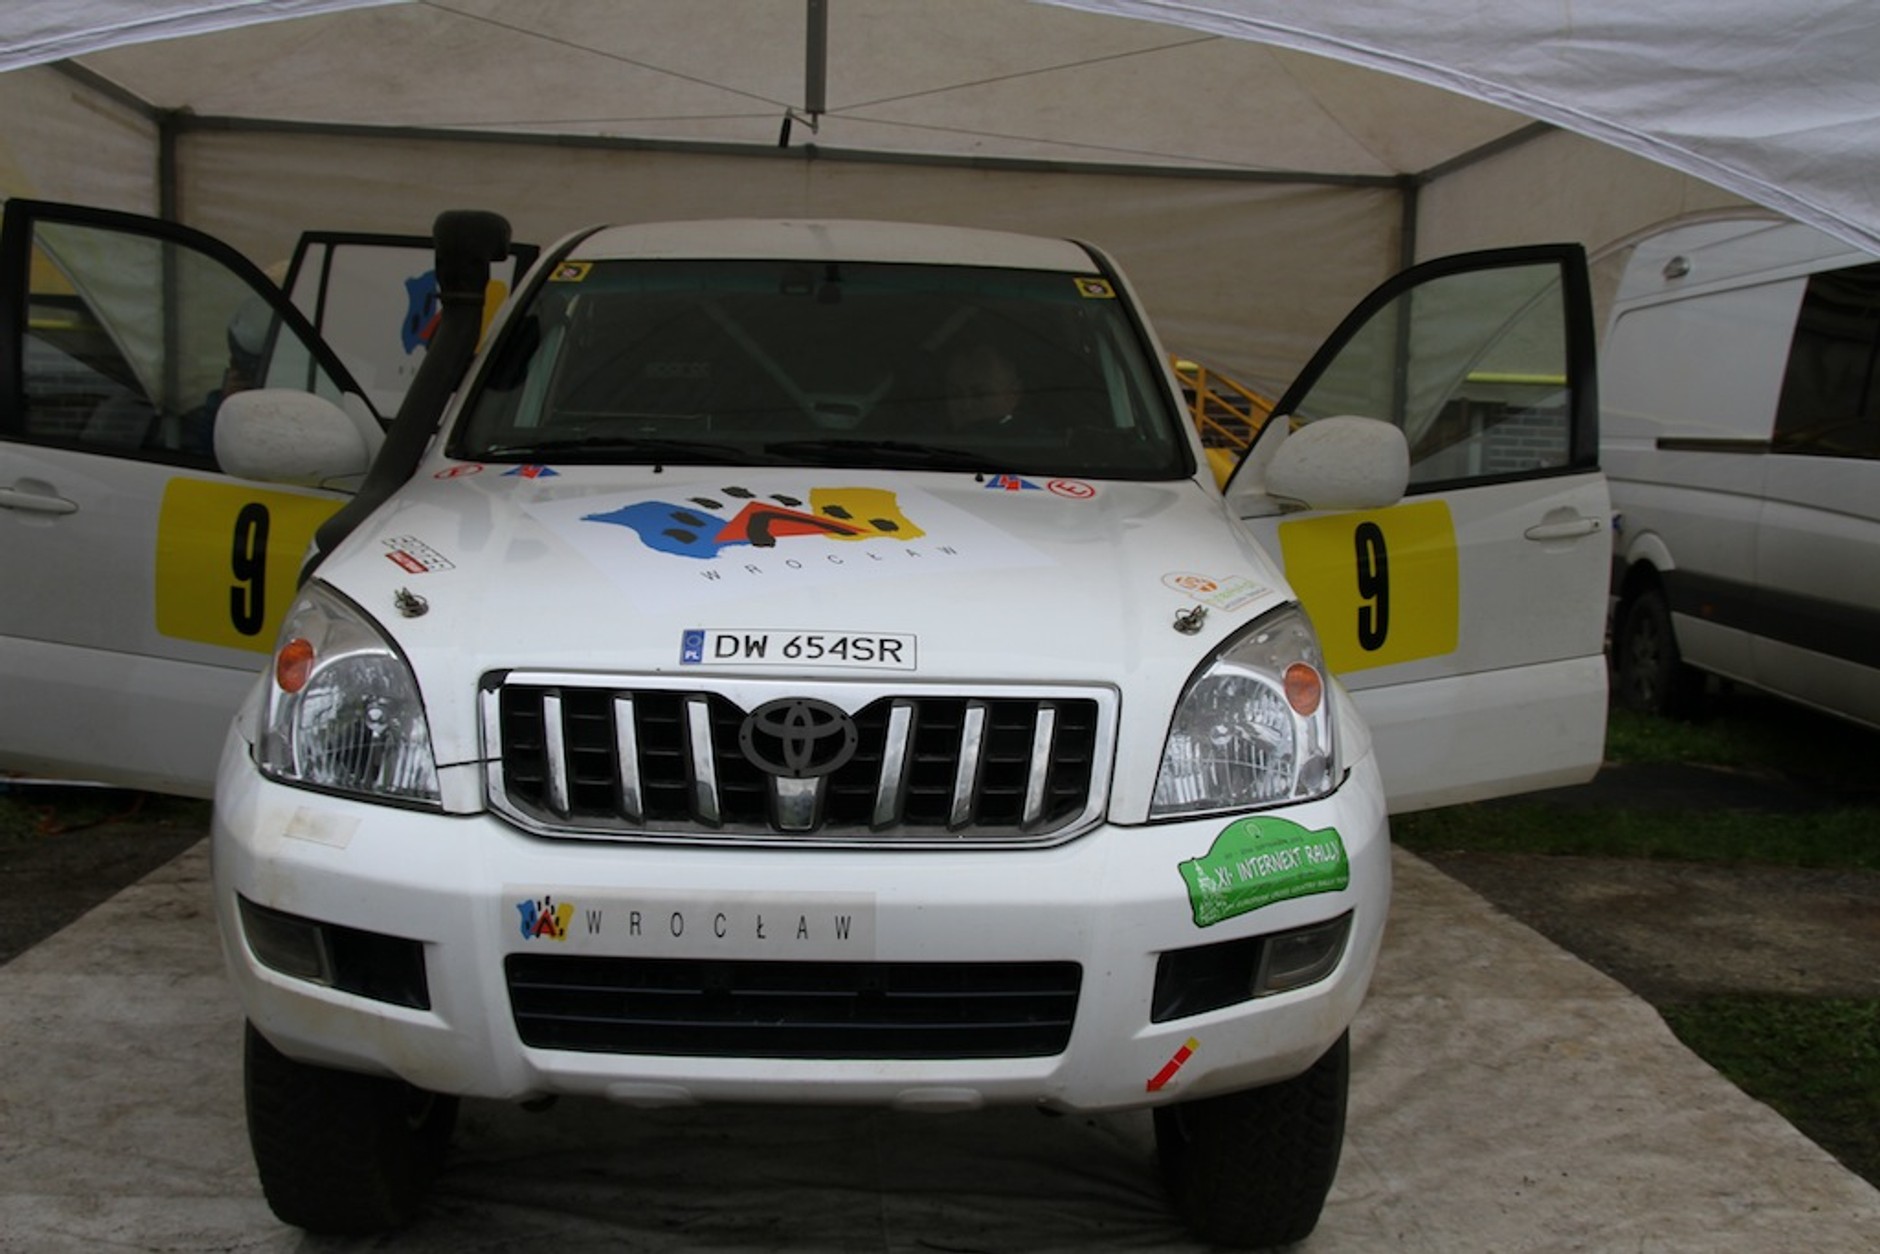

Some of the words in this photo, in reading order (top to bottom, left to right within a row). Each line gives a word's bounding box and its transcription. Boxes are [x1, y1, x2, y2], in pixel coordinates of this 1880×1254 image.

[230, 502, 270, 636] 9
[1354, 521, 1390, 652] 9
[714, 634, 769, 659] DW
[782, 635, 904, 663] 654SR
[1235, 846, 1302, 882] INTERNEXT
[1304, 841, 1340, 865] RALLY
[585, 909, 852, 940] WROCŁAW
